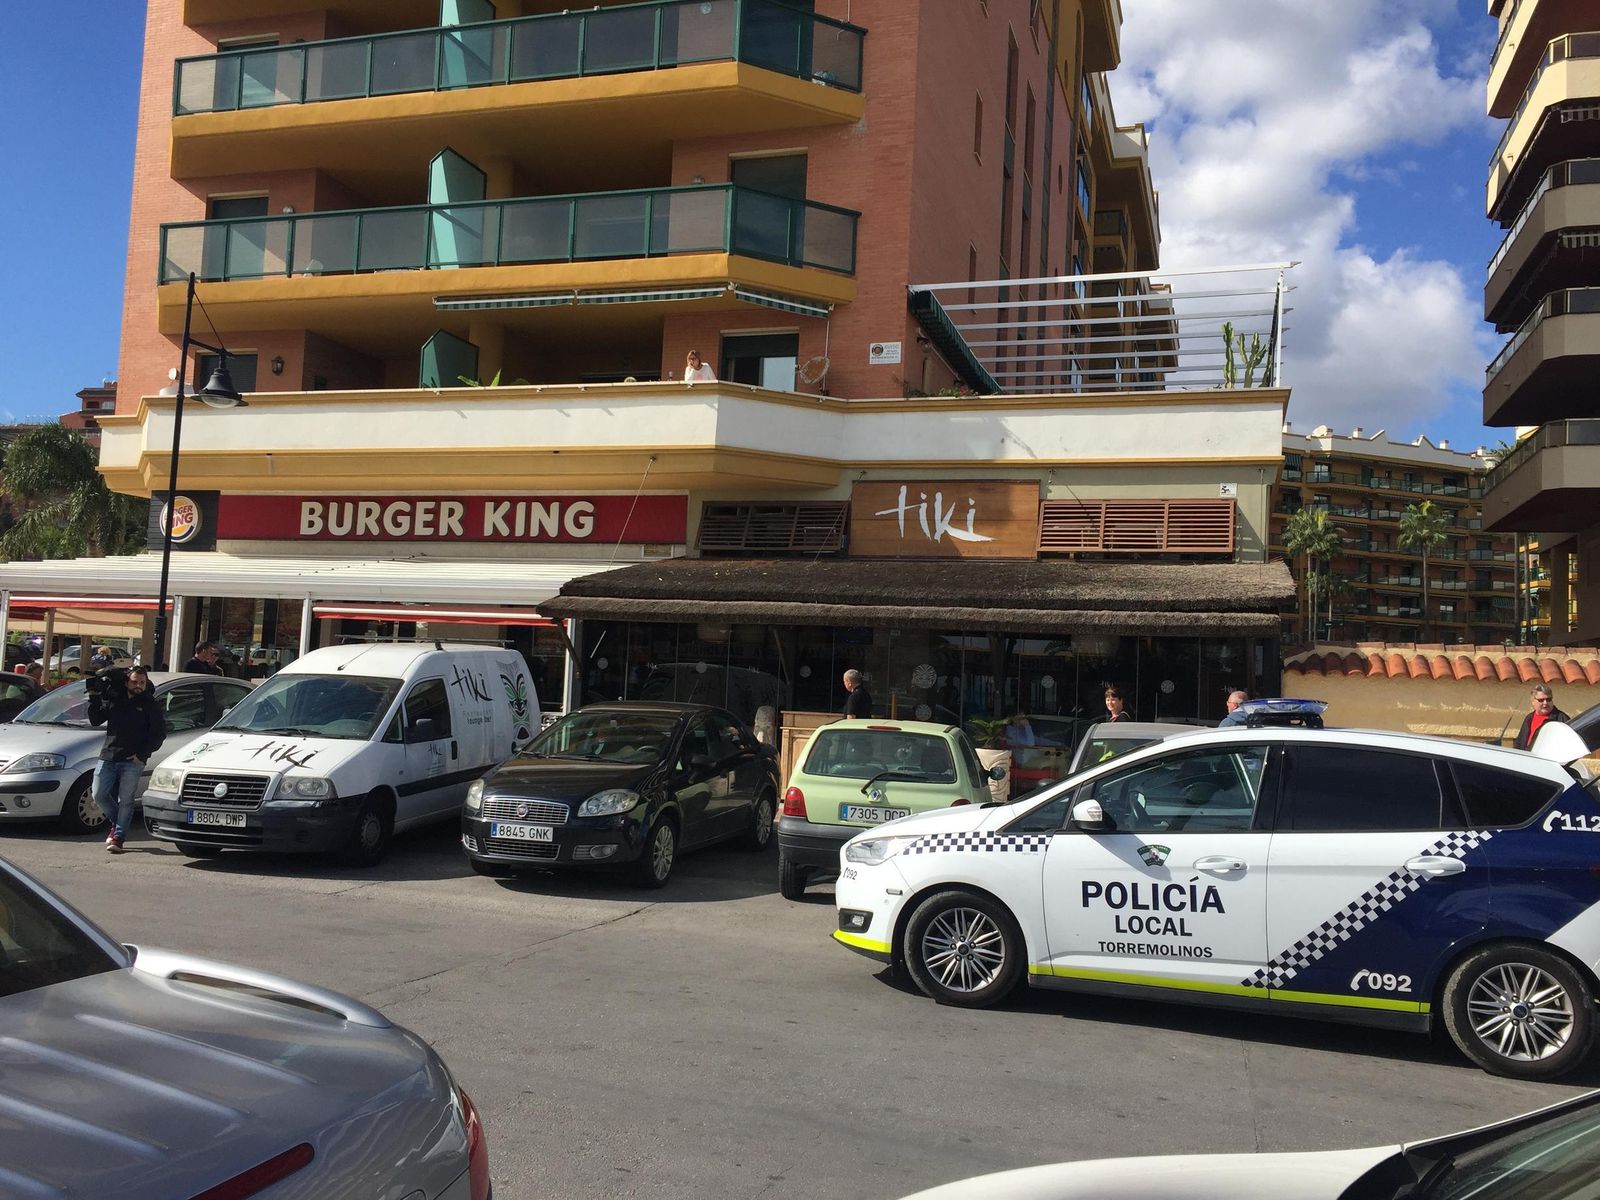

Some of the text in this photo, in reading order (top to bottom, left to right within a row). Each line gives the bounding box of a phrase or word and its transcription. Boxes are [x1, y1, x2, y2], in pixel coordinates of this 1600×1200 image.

[173, 504, 193, 516] RGER
[300, 500, 595, 538] BURGER KING
[875, 485, 998, 544] tiki
[172, 512, 194, 528] ING
[451, 664, 494, 704] tiki
[242, 740, 314, 769] tiki
[196, 812, 244, 825] 8804 DWP
[850, 807, 878, 820] 7305
[1560, 813, 1600, 832] 112
[499, 825, 550, 840] 8845 GNK
[846, 868, 858, 880] 092
[1081, 876, 1226, 914] POLICÍA
[1115, 915, 1193, 937] LOCAL
[1098, 941, 1213, 958] TORREMOLINOS
[1368, 972, 1412, 993] 092
